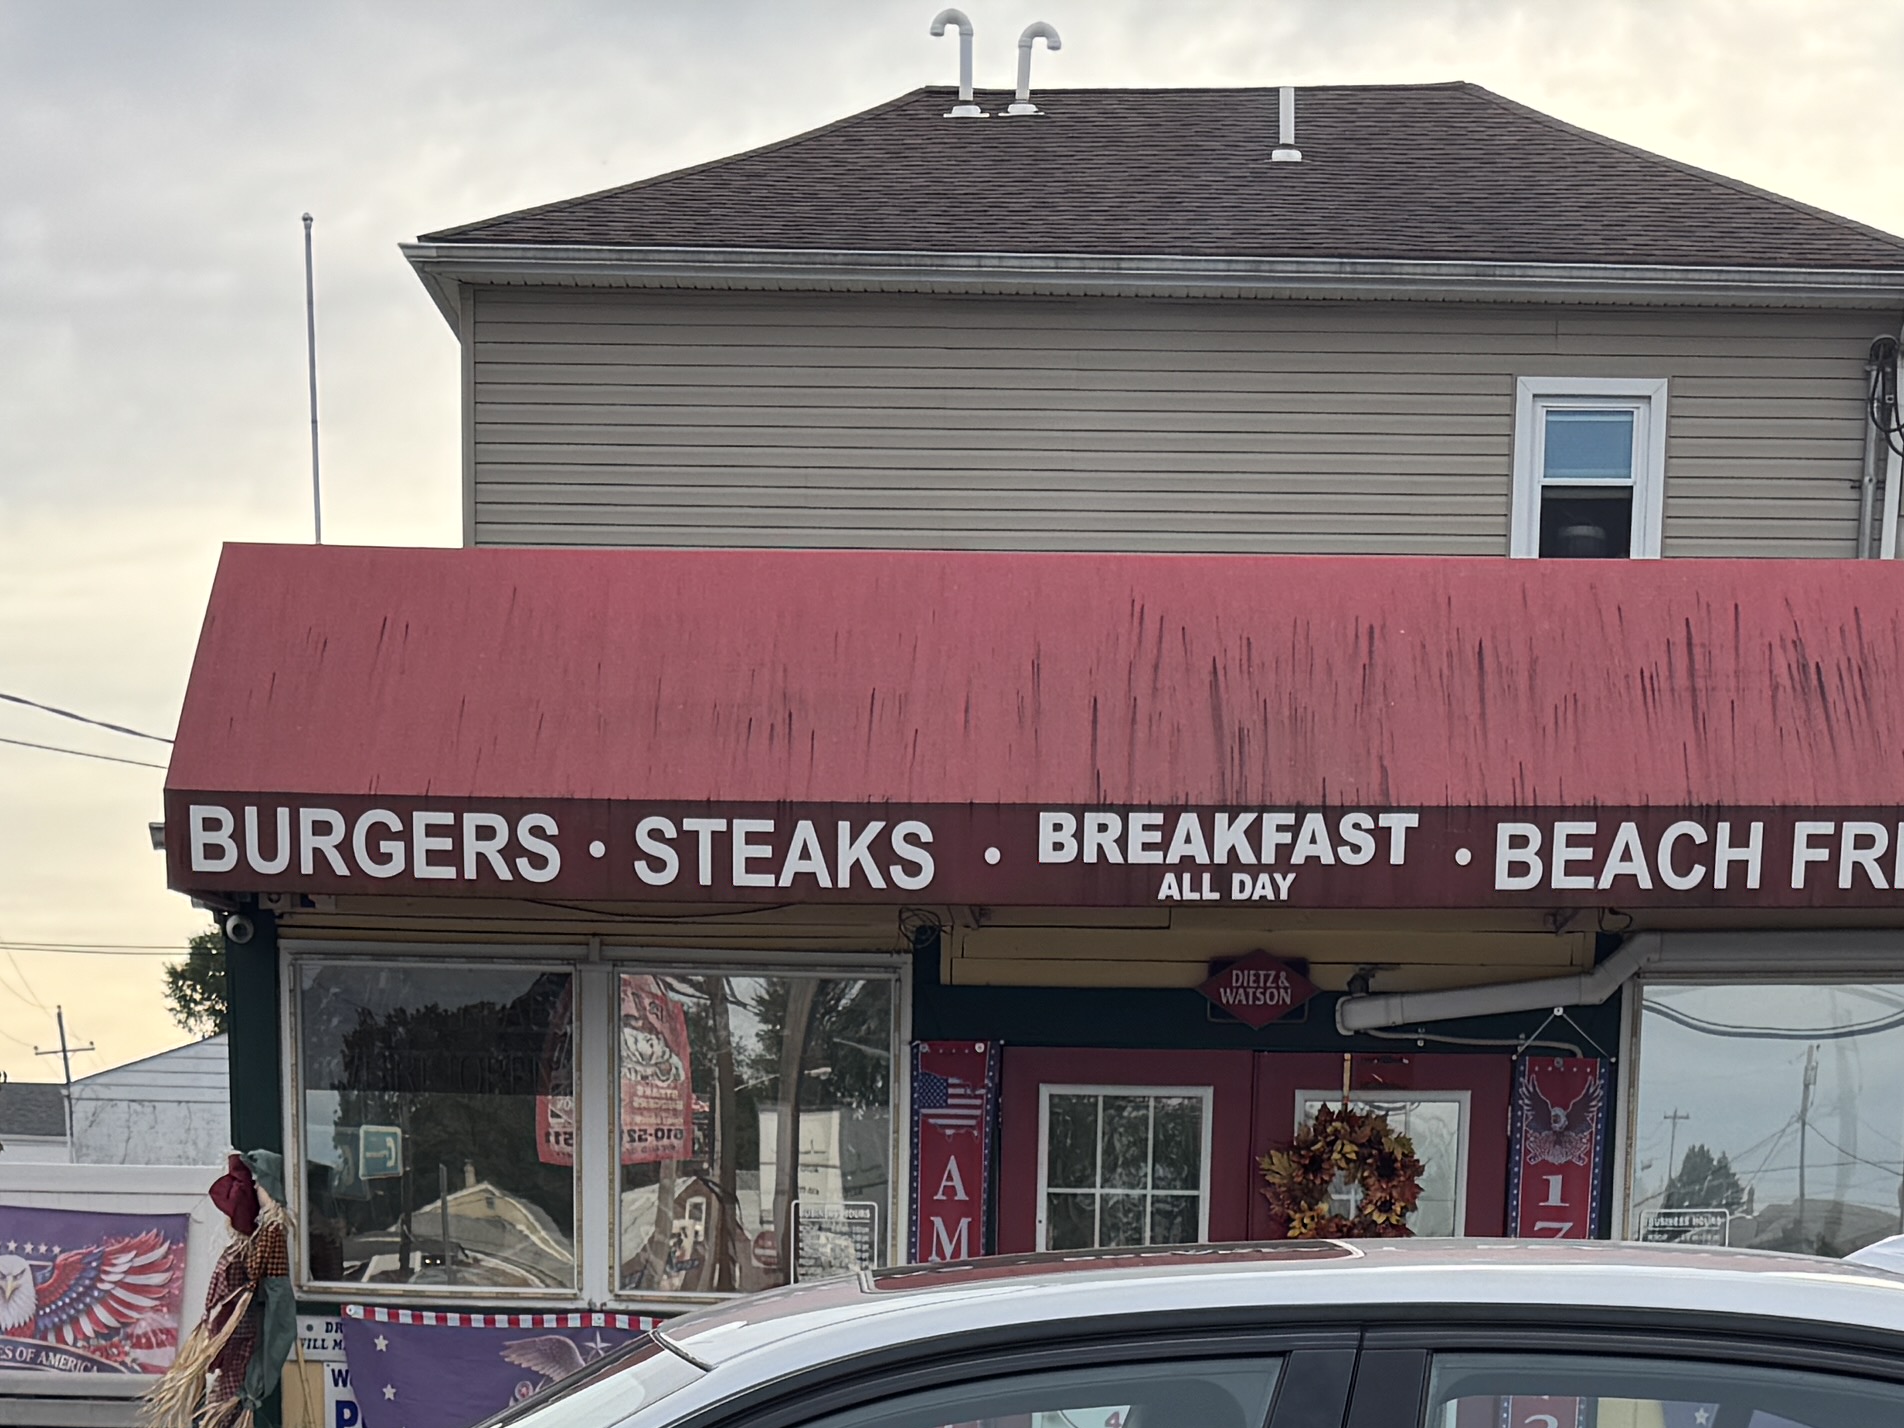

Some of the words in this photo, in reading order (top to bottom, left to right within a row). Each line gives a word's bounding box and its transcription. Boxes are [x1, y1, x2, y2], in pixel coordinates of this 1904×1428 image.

[190, 805, 560, 882] BURGERS
[635, 817, 934, 889] STEAKS
[1039, 812, 1418, 864] BREAKFAST
[1495, 821, 1763, 889] BEACH
[1158, 873, 1219, 900] ALL
[1232, 873, 1296, 900] DAY
[1232, 970, 1276, 988] DIETZ
[1278, 971, 1290, 987] &
[1219, 987, 1291, 1005] WATSON
[15, 1346, 35, 1362] OF
